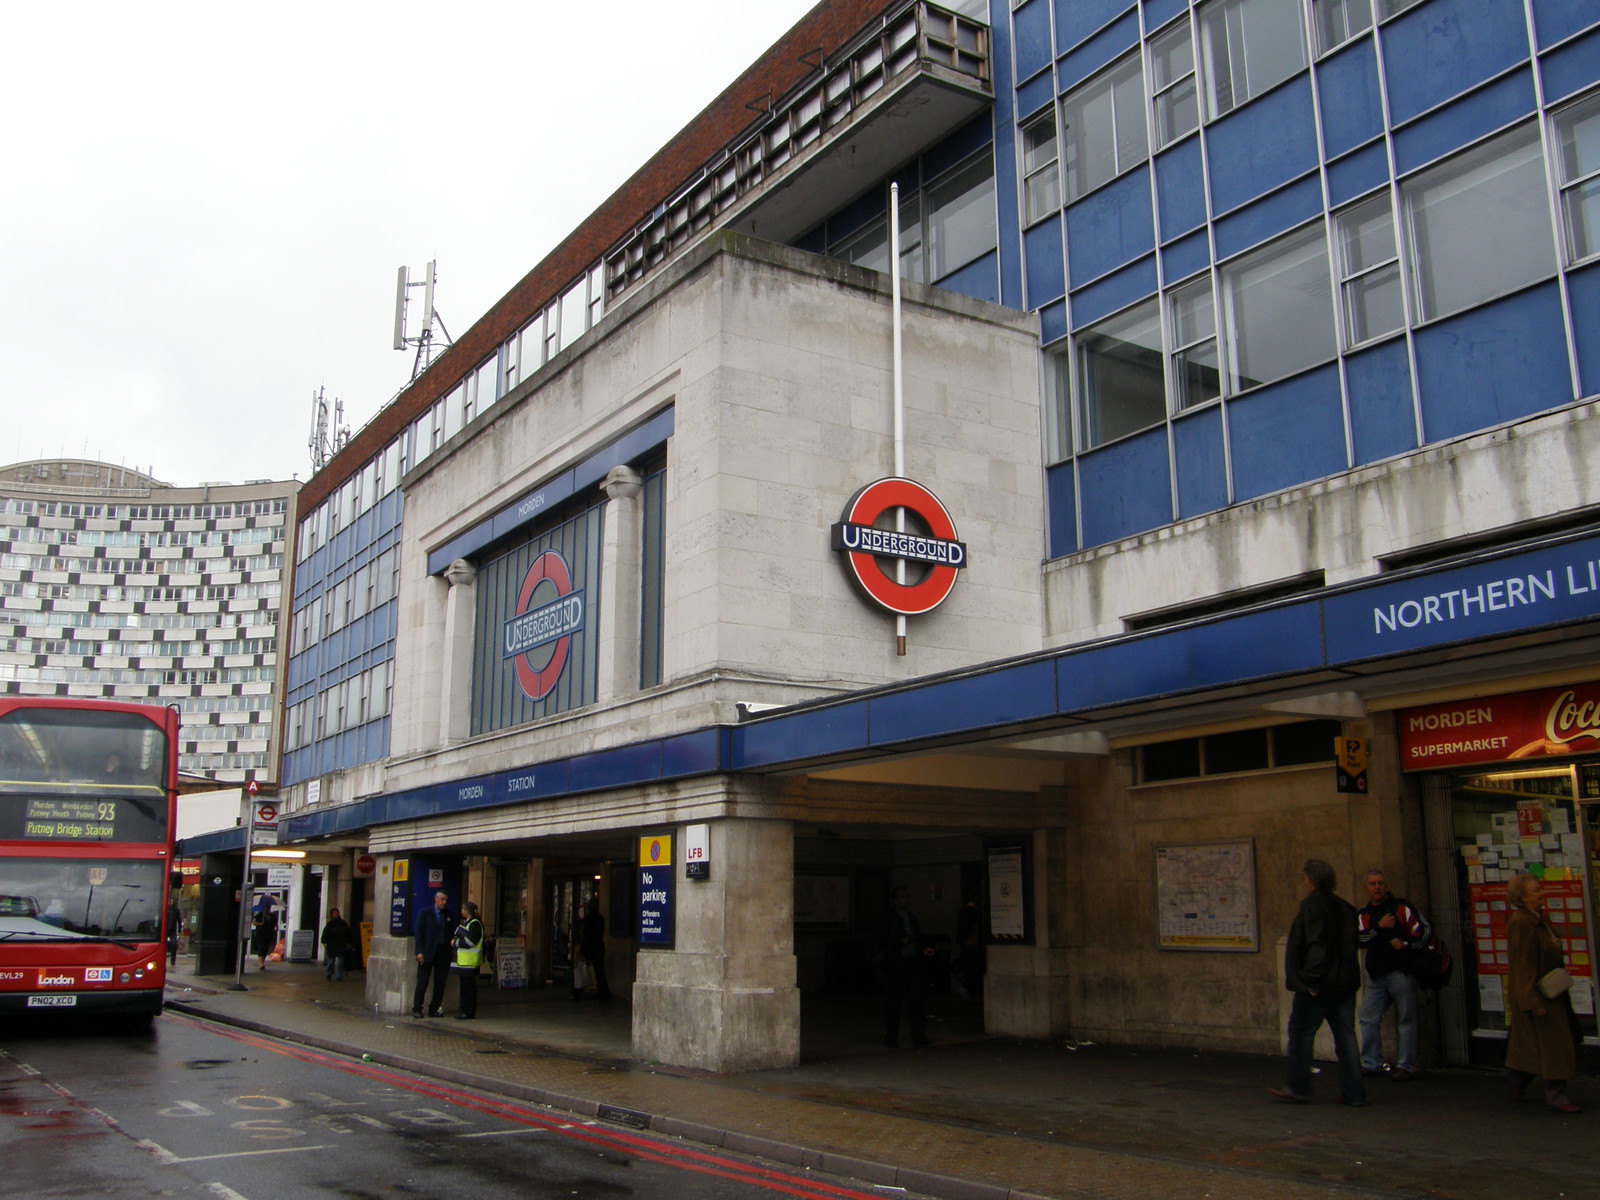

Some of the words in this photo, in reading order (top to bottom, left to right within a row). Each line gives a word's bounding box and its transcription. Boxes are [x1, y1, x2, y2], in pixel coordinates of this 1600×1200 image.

[518, 493, 545, 518] MORDEN
[842, 524, 963, 564] UNDERGROUND
[1374, 569, 1556, 634] NORTHERN
[1566, 559, 1600, 595] LI
[506, 597, 582, 652] UNDERGROUND
[1409, 707, 1493, 732] MORDEN
[1411, 736, 1509, 758] SUPERMARKET
[249, 781, 258, 791] A
[458, 785, 483, 801] MORDEN
[508, 775, 535, 792] STATION
[33, 801, 55, 810] Morden
[61, 802, 94, 811] Wimbledon
[98, 803, 116, 821] 93
[30, 809, 50, 818] Putney
[76, 811, 96, 819] Putney
[1520, 809, 1534, 821] 21
[27, 822, 54, 837] Putney
[57, 823, 82, 837] Bridge
[85, 824, 114, 836] Station
[688, 847, 703, 859] LFB
[642, 872, 653, 885] No
[642, 889, 666, 904] parking
[642, 926, 661, 934] prosecuted
[0, 972, 24, 980] EVL29
[38, 974, 75, 985] London
[32, 997, 55, 1005] PN02
